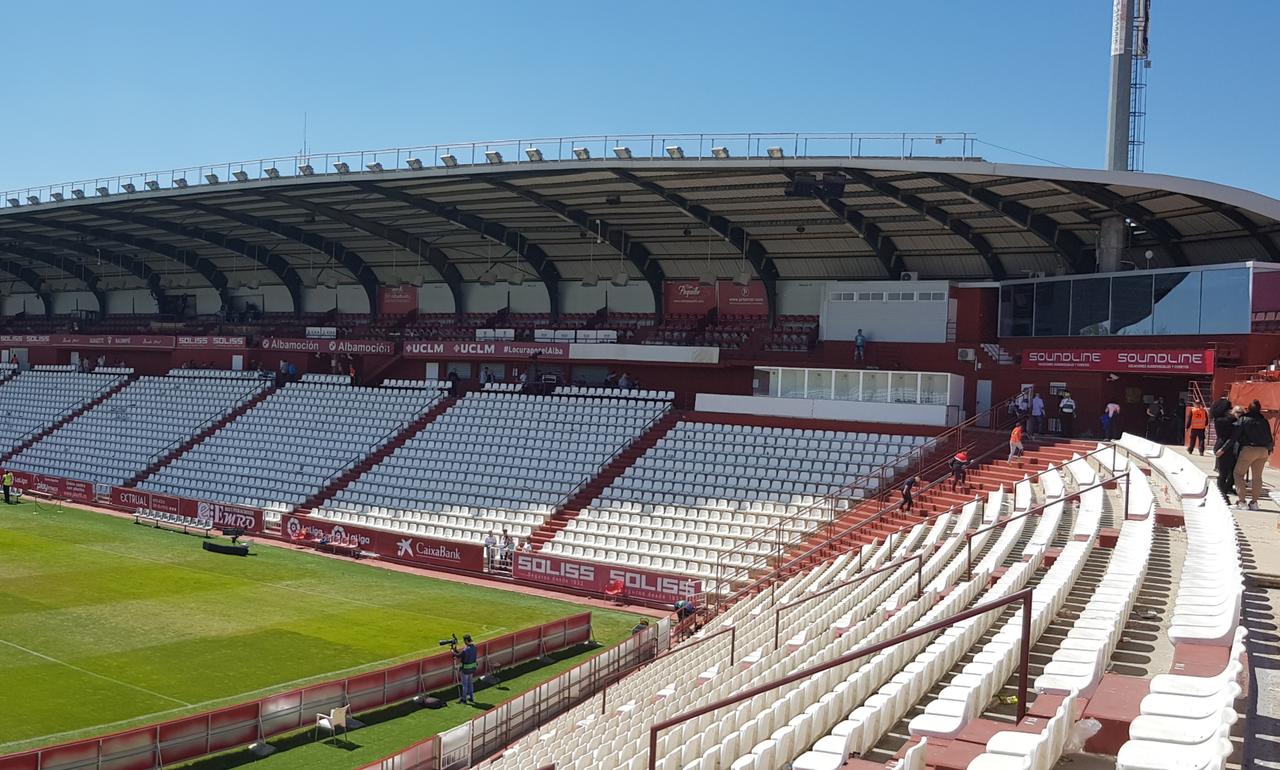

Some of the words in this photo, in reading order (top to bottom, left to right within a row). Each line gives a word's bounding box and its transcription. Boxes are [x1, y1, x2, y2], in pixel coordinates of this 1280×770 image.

[212, 337, 243, 345] SOLISS
[271, 339, 319, 350] Albamoción
[412, 344, 444, 353] UCLM
[460, 344, 495, 354] UCLM
[1029, 352, 1101, 362] SOUNDLINE
[1117, 353, 1202, 364] SOUNDLINE
[120, 493, 147, 506] EXTRUAL
[416, 542, 460, 559] CaixaBank
[518, 555, 595, 581] SOLISS
[609, 569, 695, 596] SOLISS
